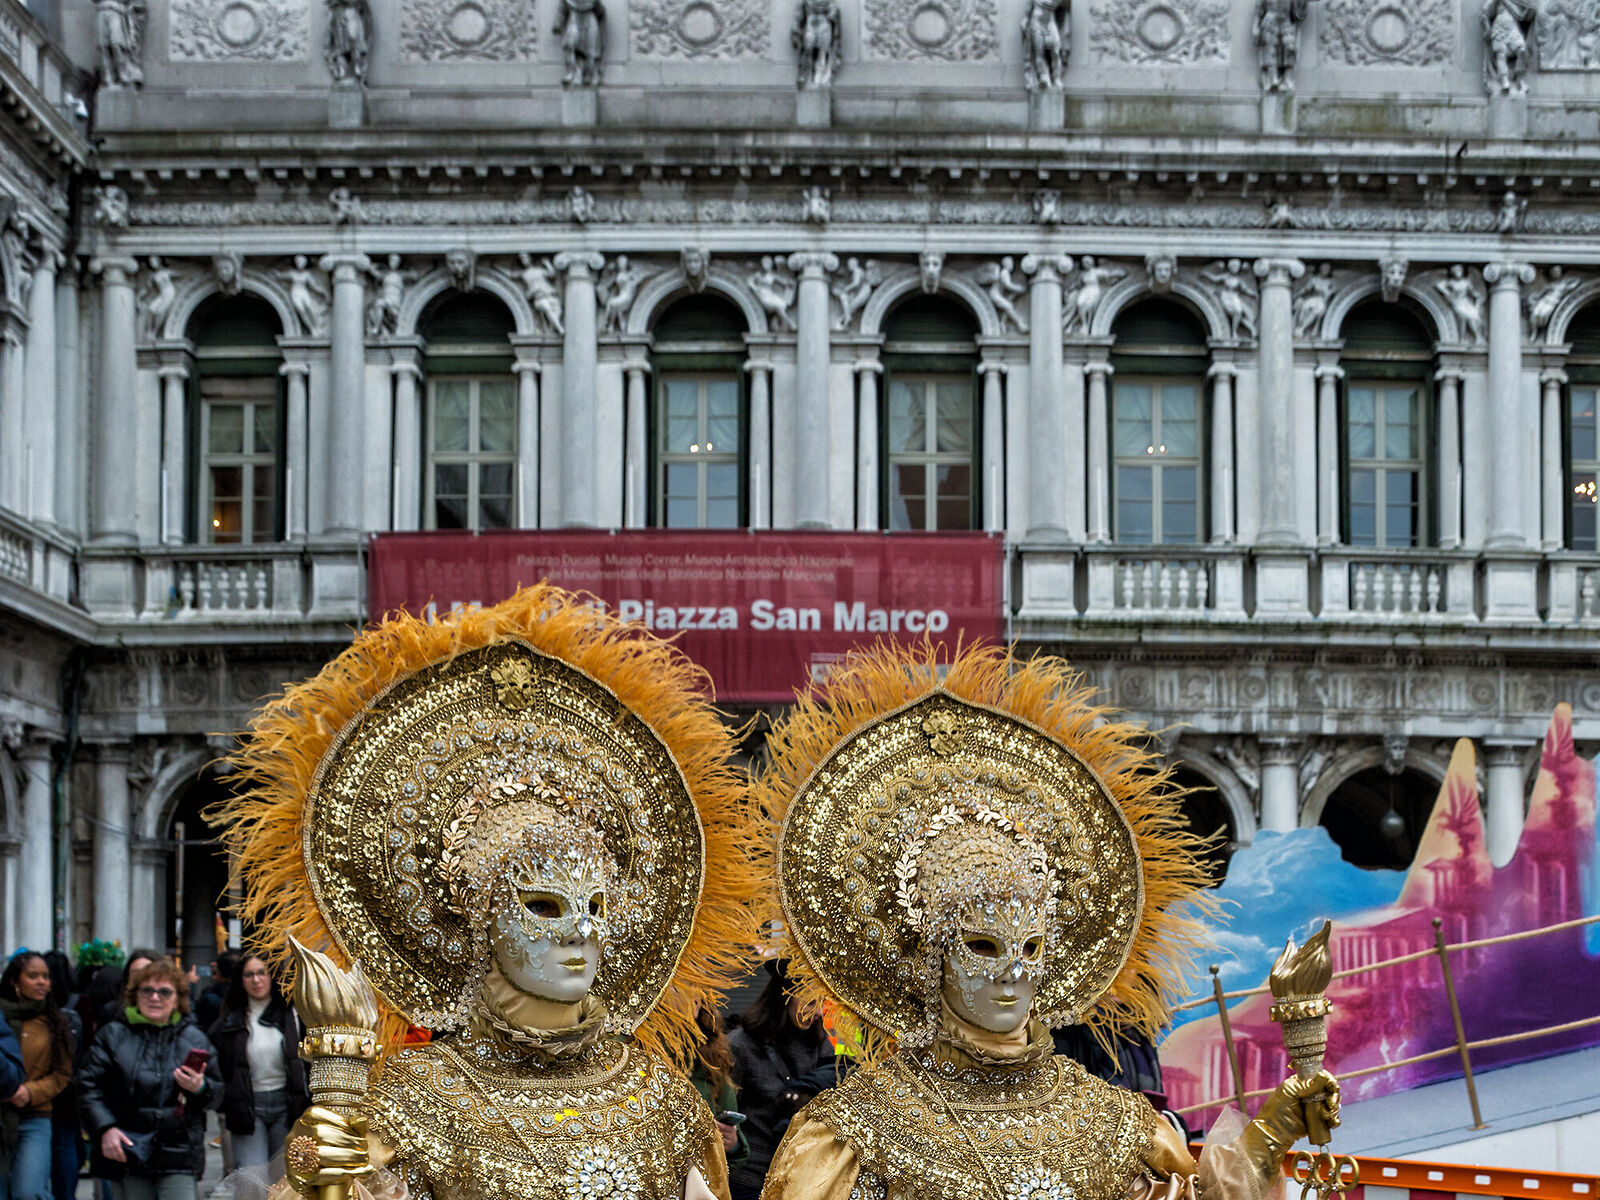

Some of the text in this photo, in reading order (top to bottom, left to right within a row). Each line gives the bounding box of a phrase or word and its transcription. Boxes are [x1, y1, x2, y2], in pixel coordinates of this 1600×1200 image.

[619, 600, 738, 630] Piazza
[751, 600, 821, 631] San
[834, 602, 949, 632] Marco
